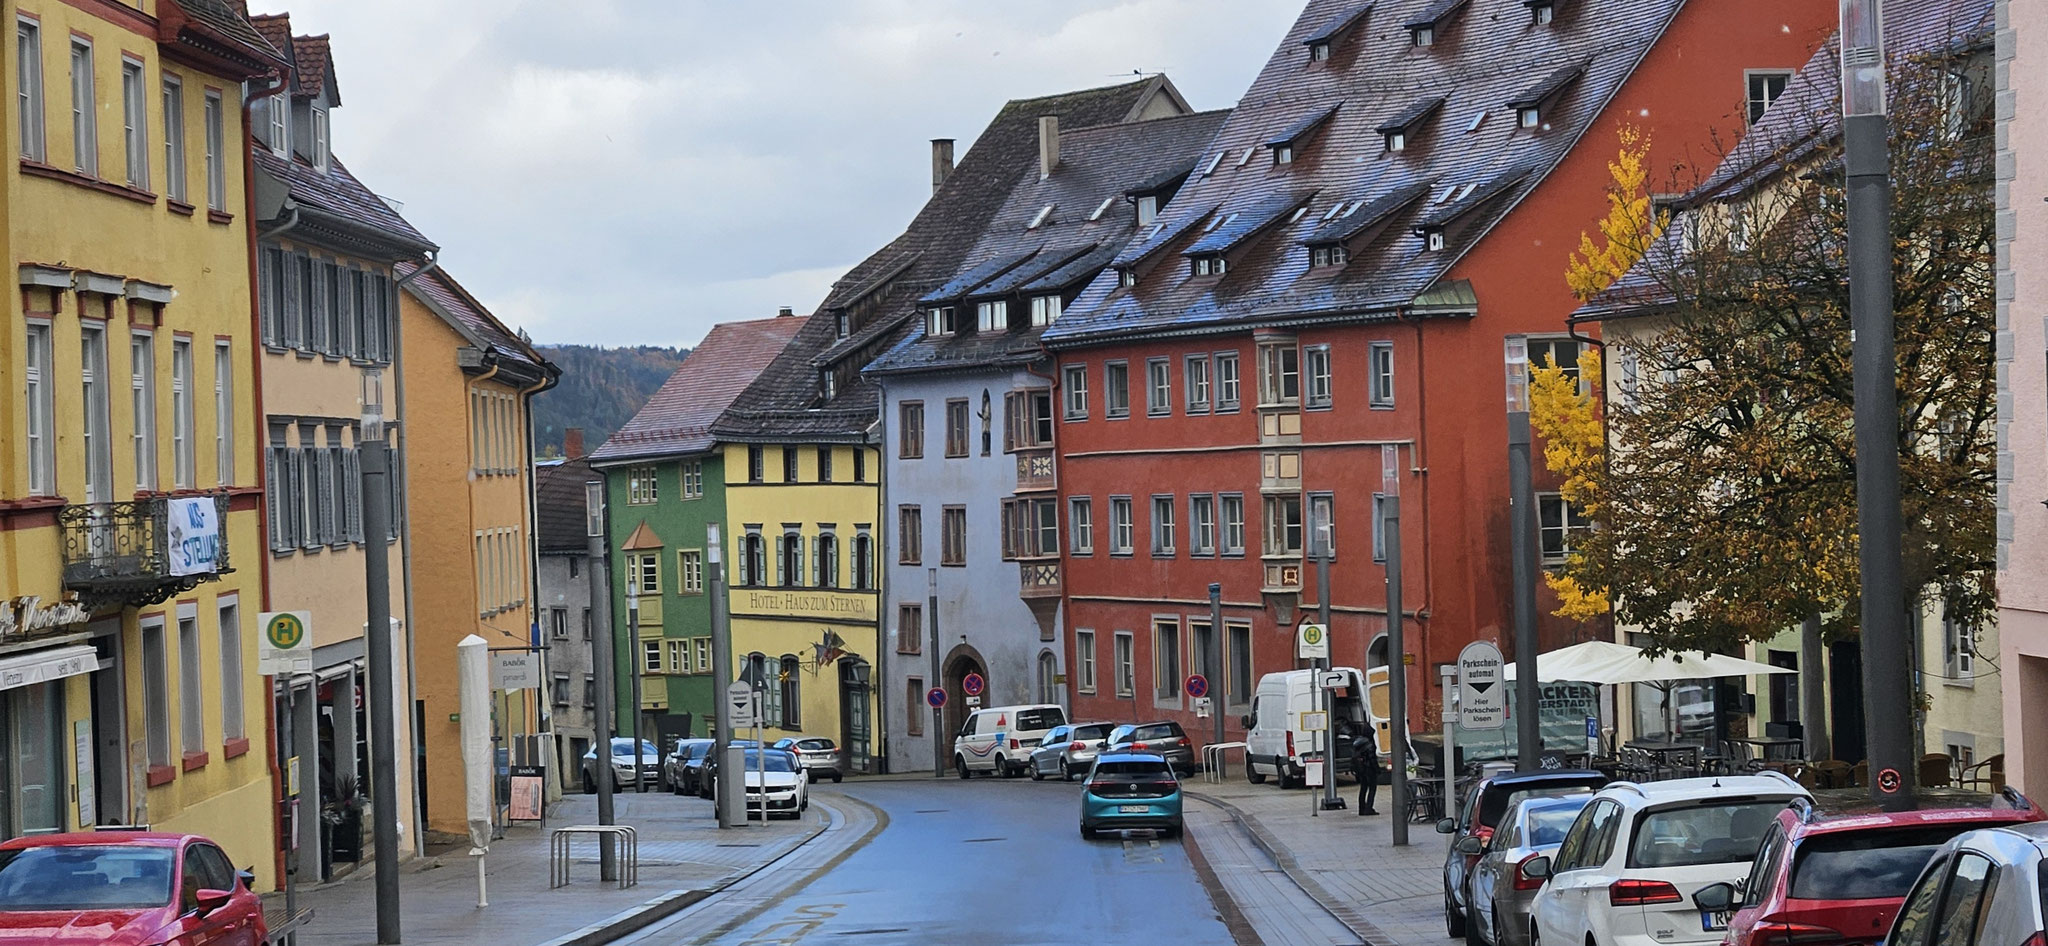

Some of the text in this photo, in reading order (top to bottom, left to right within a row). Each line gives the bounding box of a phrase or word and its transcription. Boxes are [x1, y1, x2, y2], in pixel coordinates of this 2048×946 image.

[750, 592, 866, 613] HOTEL HAUS ZUM STERNEN
[276, 622, 294, 641] H
[1308, 630, 1317, 640] H
[1463, 658, 1500, 668] Parkschein-
[1468, 669, 1494, 678] automat
[1538, 700, 1592, 709] ERSTADT
[1463, 706, 1501, 714] Parkschein
